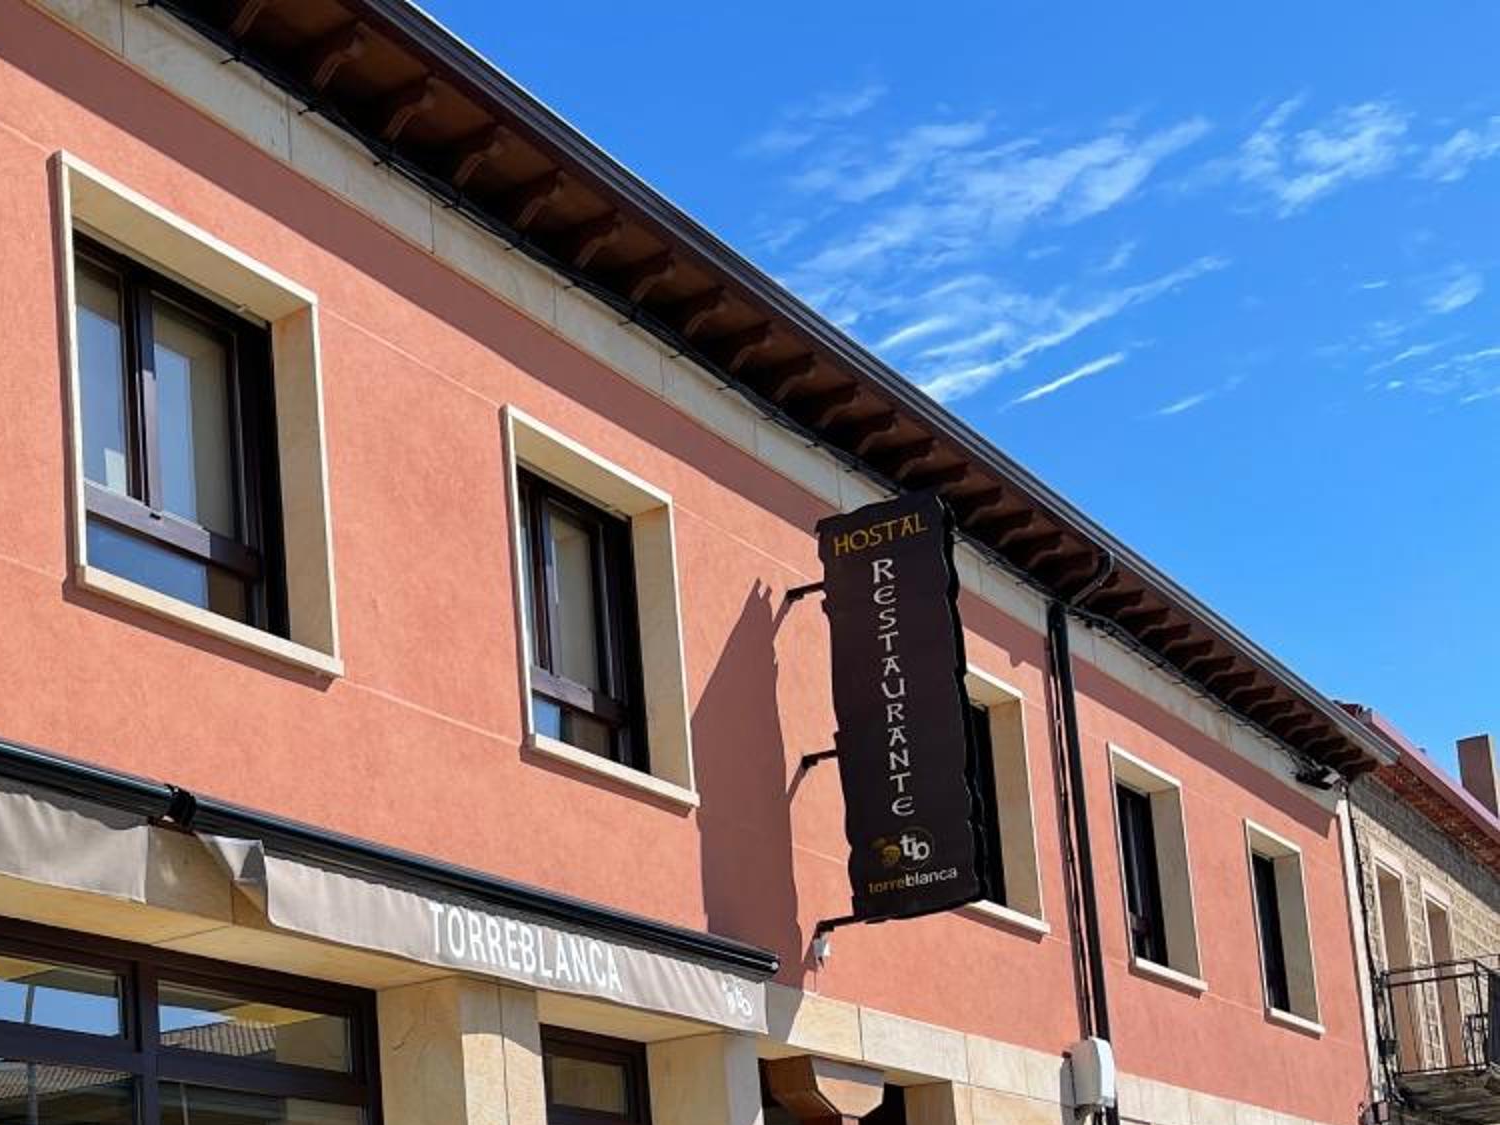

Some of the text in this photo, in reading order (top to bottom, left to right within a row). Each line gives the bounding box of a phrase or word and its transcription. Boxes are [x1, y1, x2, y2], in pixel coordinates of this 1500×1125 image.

[833, 512, 927, 557] HOSTAL
[871, 559, 915, 817] RESTAURANTE
[868, 867, 958, 893] torreblanca
[428, 902, 624, 993] TORREBLANCA
